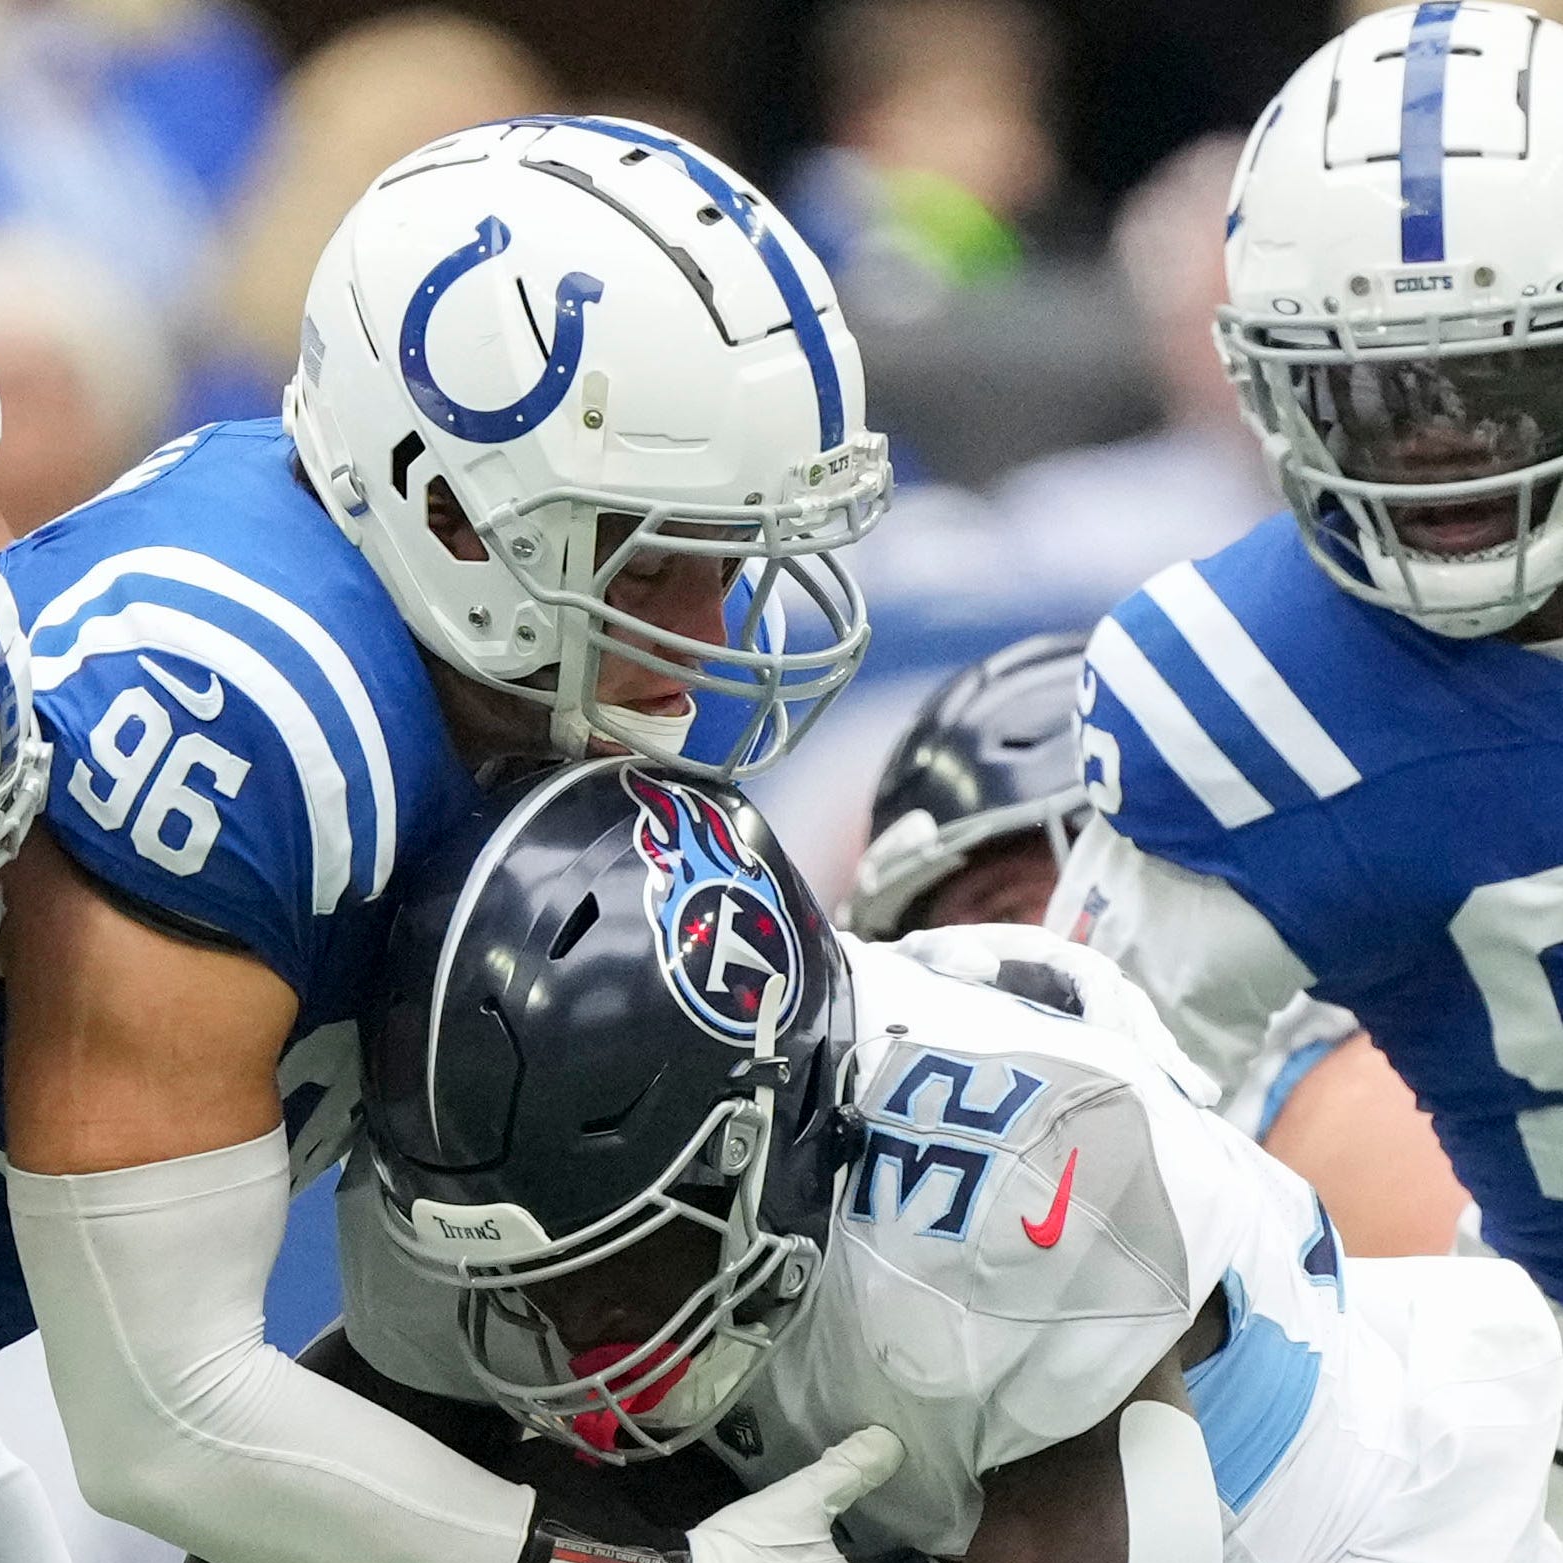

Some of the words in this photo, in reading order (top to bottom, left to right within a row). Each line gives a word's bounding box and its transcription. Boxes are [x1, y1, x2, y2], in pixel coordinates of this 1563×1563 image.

[1394, 276, 1453, 294] COLTS
[67, 686, 253, 878] 96
[846, 1047, 1054, 1243] 32
